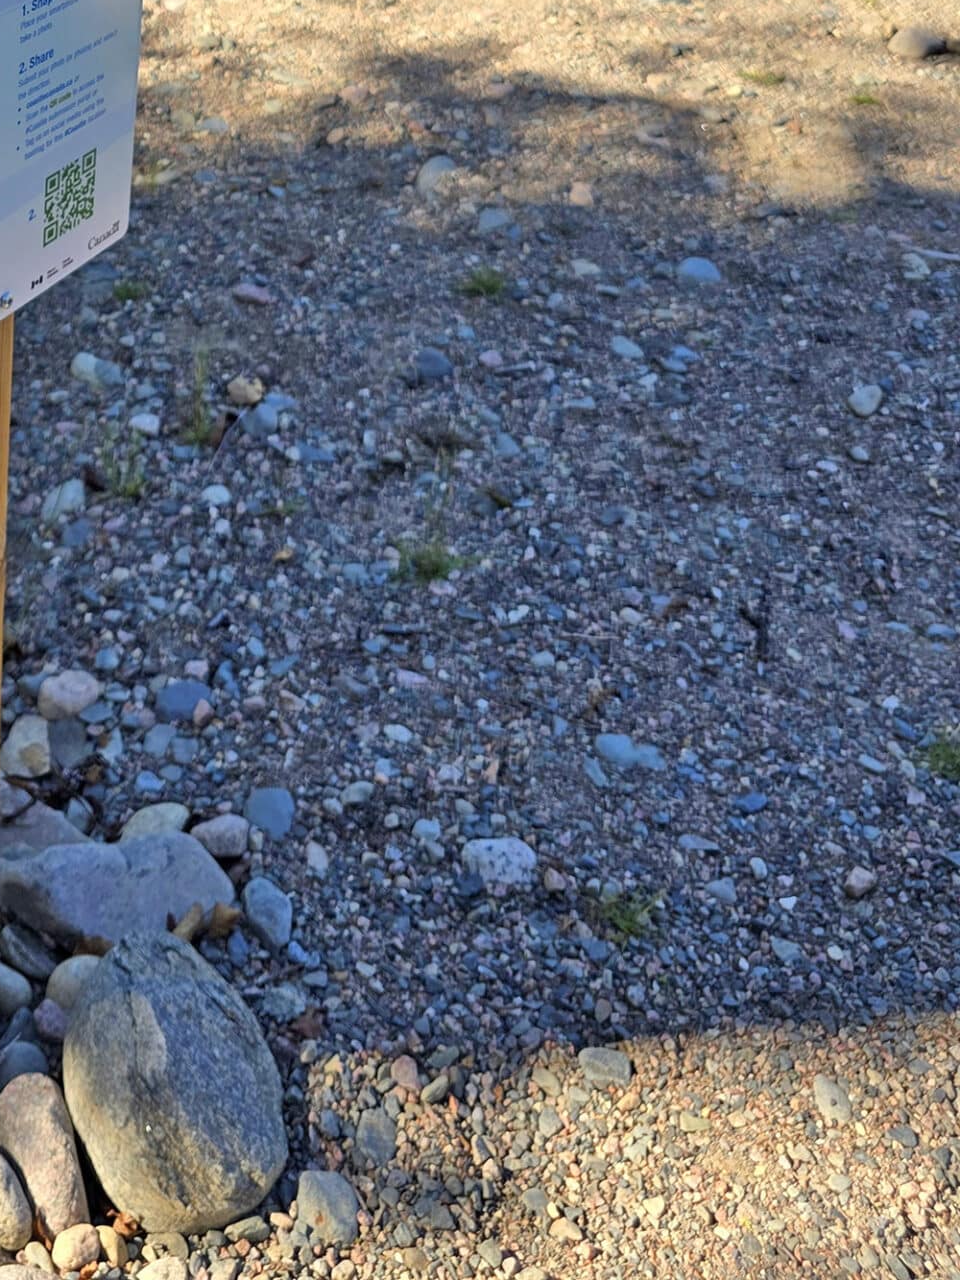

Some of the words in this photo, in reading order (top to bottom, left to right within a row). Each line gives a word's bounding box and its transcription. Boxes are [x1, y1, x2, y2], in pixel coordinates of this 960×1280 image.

[22, 4, 30, 16] 1.
[19, 62, 27, 75] 2.
[29, 49, 54, 69] Share
